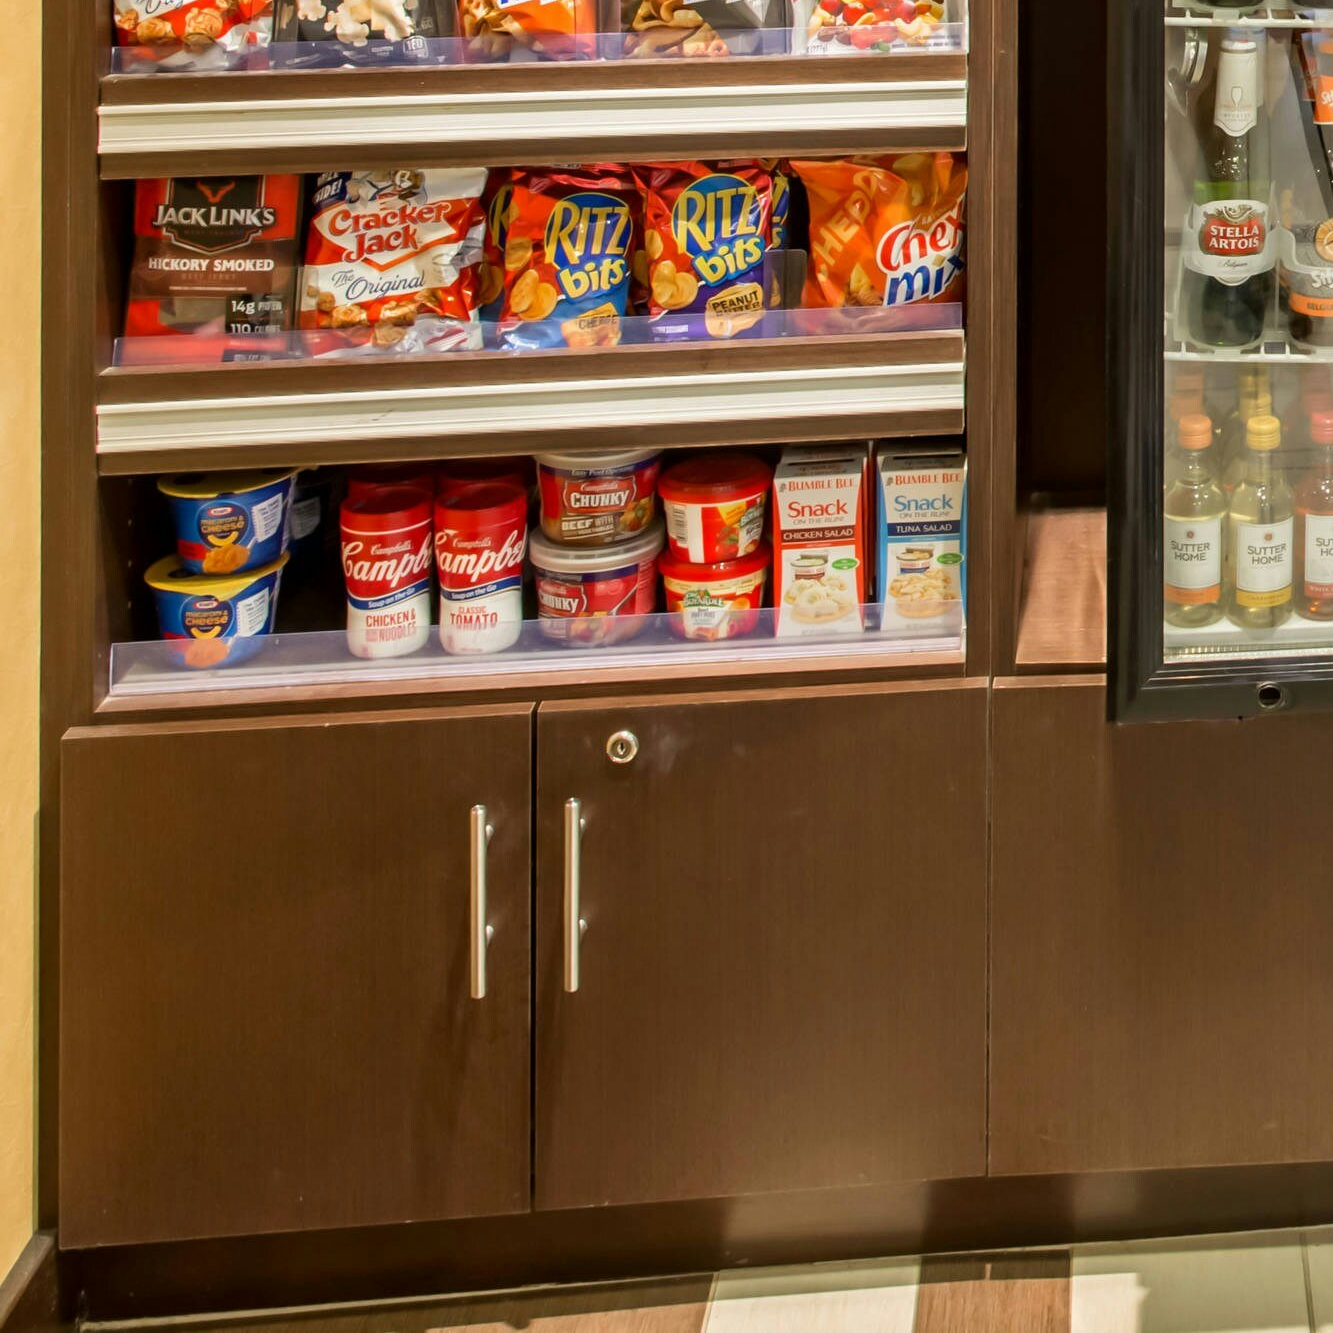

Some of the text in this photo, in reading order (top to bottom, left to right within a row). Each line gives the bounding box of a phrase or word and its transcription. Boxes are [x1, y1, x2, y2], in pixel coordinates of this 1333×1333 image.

[153, 205, 275, 227] JACK LINK'S
[328, 201, 452, 237] Cracker
[674, 185, 761, 254] RITZ
[546, 199, 631, 266] RITZ
[1210, 224, 1260, 238] STELLA
[342, 225, 421, 263] Jack
[1209, 236, 1260, 250] ARTOIS
[148, 257, 274, 272] HICKORY SMOKED
[693, 236, 765, 285] bits
[331, 268, 426, 300] The Original
[560, 257, 628, 298] bits
[788, 477, 855, 492] BUMBLE BEE
[895, 472, 961, 486] BUMBLE BEE
[570, 490, 629, 508] CHUNKY
[893, 494, 954, 513] Snack
[787, 498, 849, 520] Snack
[783, 527, 854, 541] CHICKEN SALAD
[896, 523, 953, 534] TUNA SALAD
[1170, 540, 1210, 552] SUTTER
[1247, 543, 1287, 555] SUTTER
[1174, 550, 1206, 562] HOME
[1252, 554, 1284, 565] HOME
[365, 610, 409, 628] CHICKEN
[450, 611, 499, 630] TOMATO
